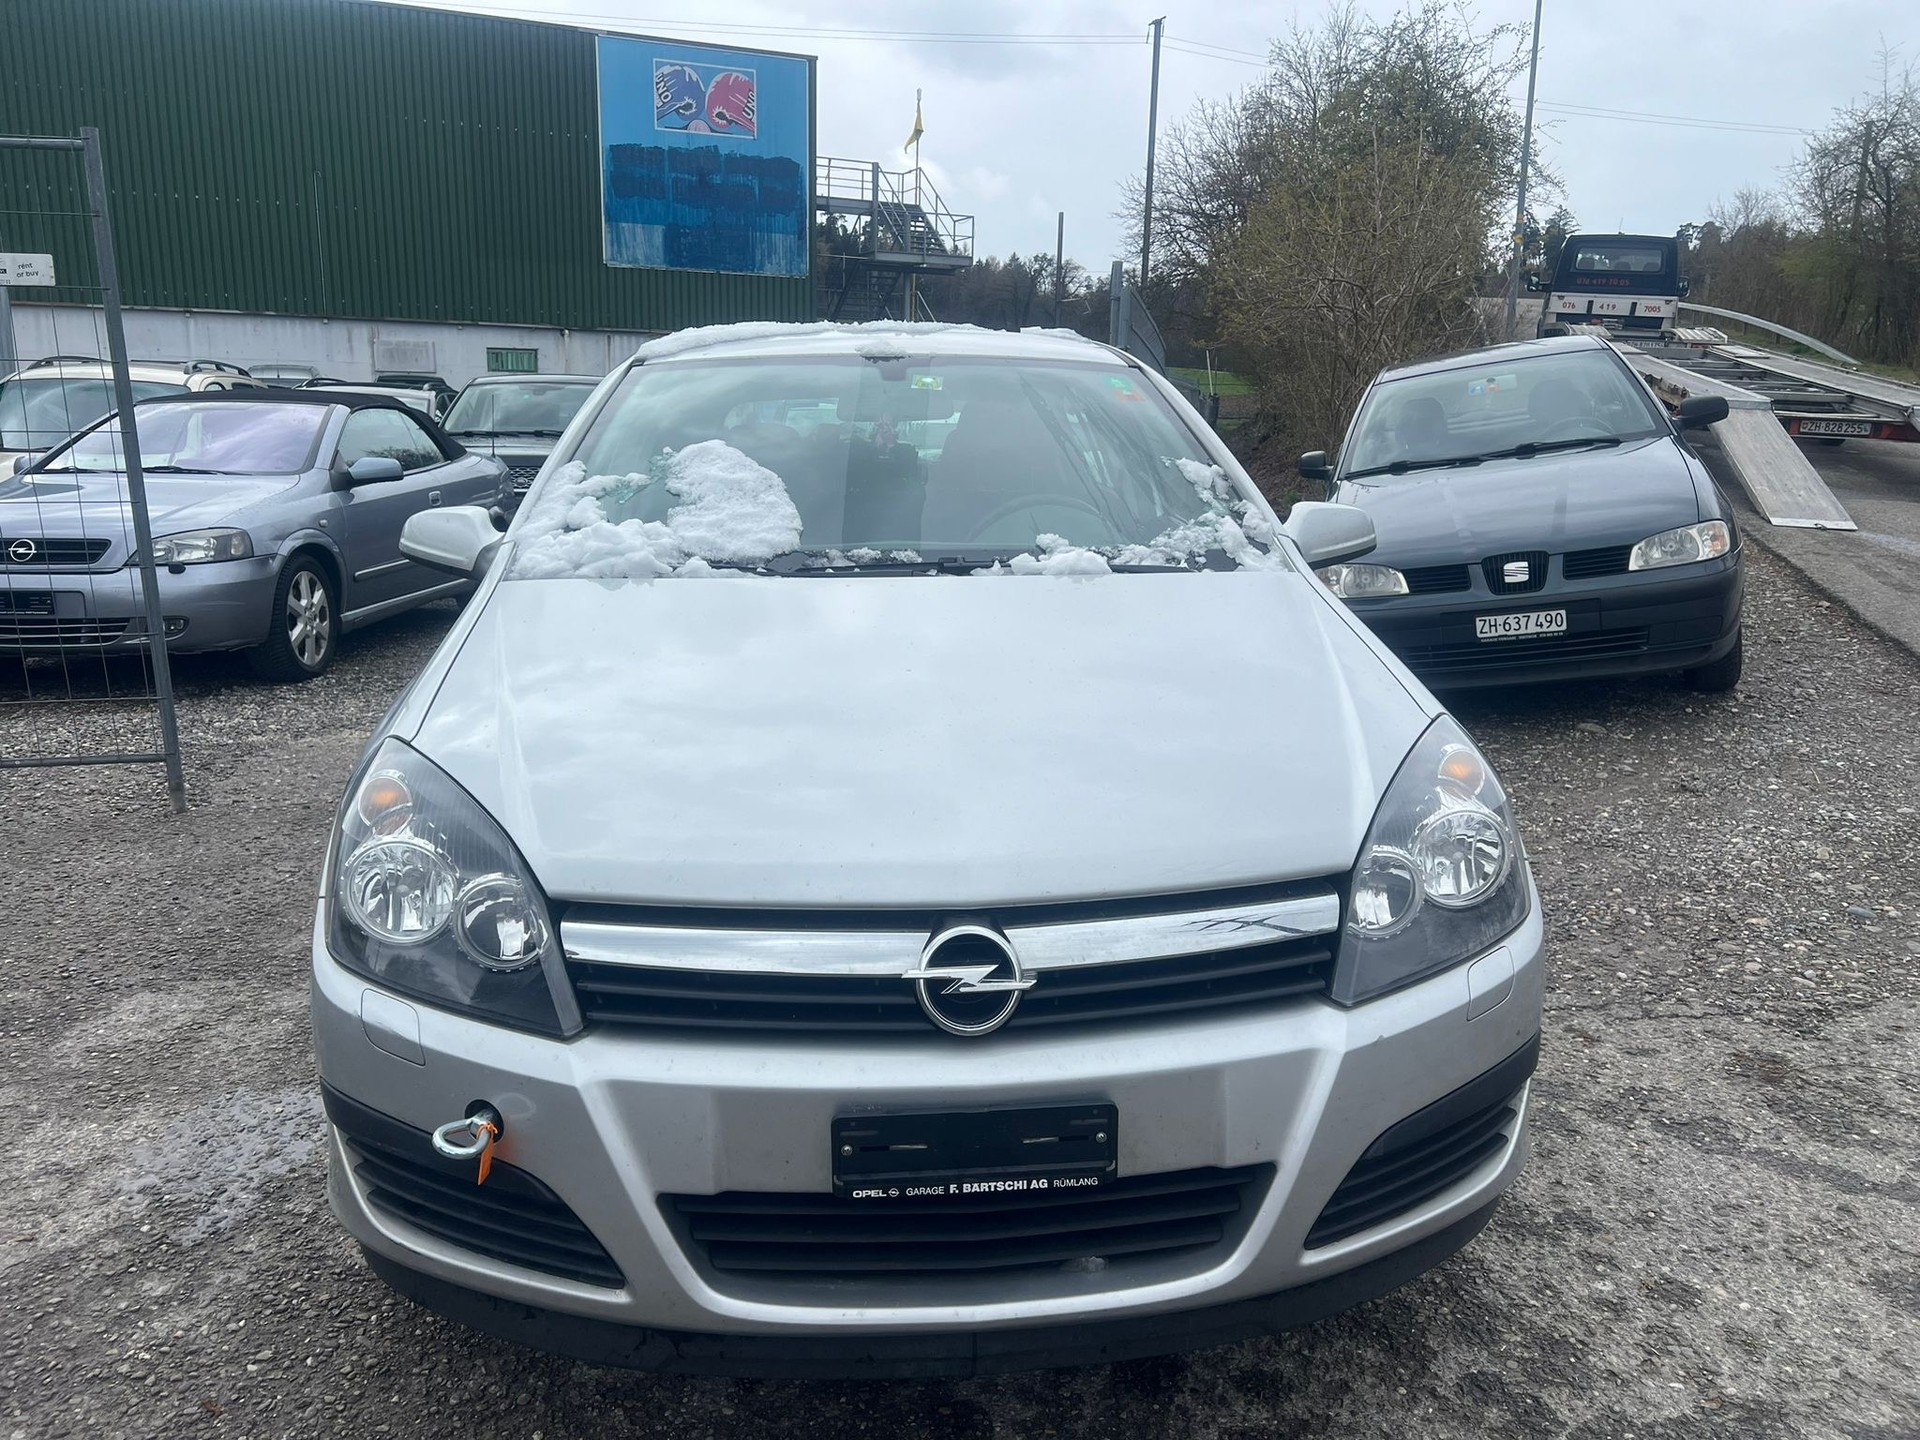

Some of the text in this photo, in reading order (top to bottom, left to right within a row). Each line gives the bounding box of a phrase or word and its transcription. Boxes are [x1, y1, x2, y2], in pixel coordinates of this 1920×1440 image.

[656, 73, 672, 103] UNO
[1562, 301, 1576, 309] 076
[1644, 305, 1661, 313] 7005
[852, 1177, 1099, 1198] OPEL GARAGE F. BÄRTSCHI AG RÜMLANG
